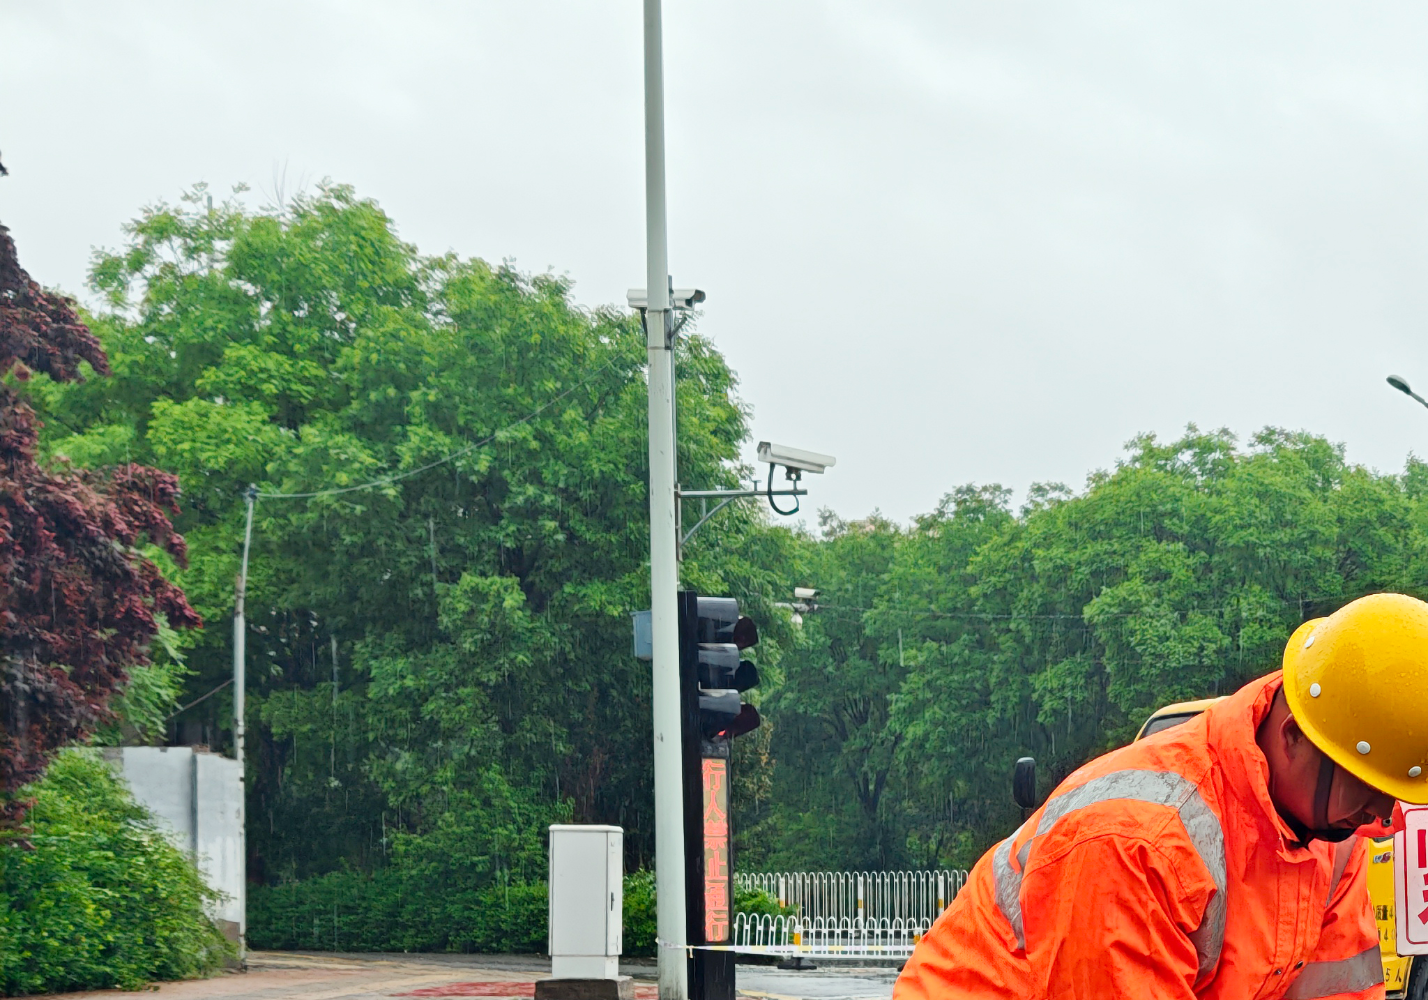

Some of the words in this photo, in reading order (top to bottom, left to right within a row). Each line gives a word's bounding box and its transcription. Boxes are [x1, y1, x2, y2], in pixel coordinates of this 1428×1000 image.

[702, 758, 729, 942] 行人禁止通行
